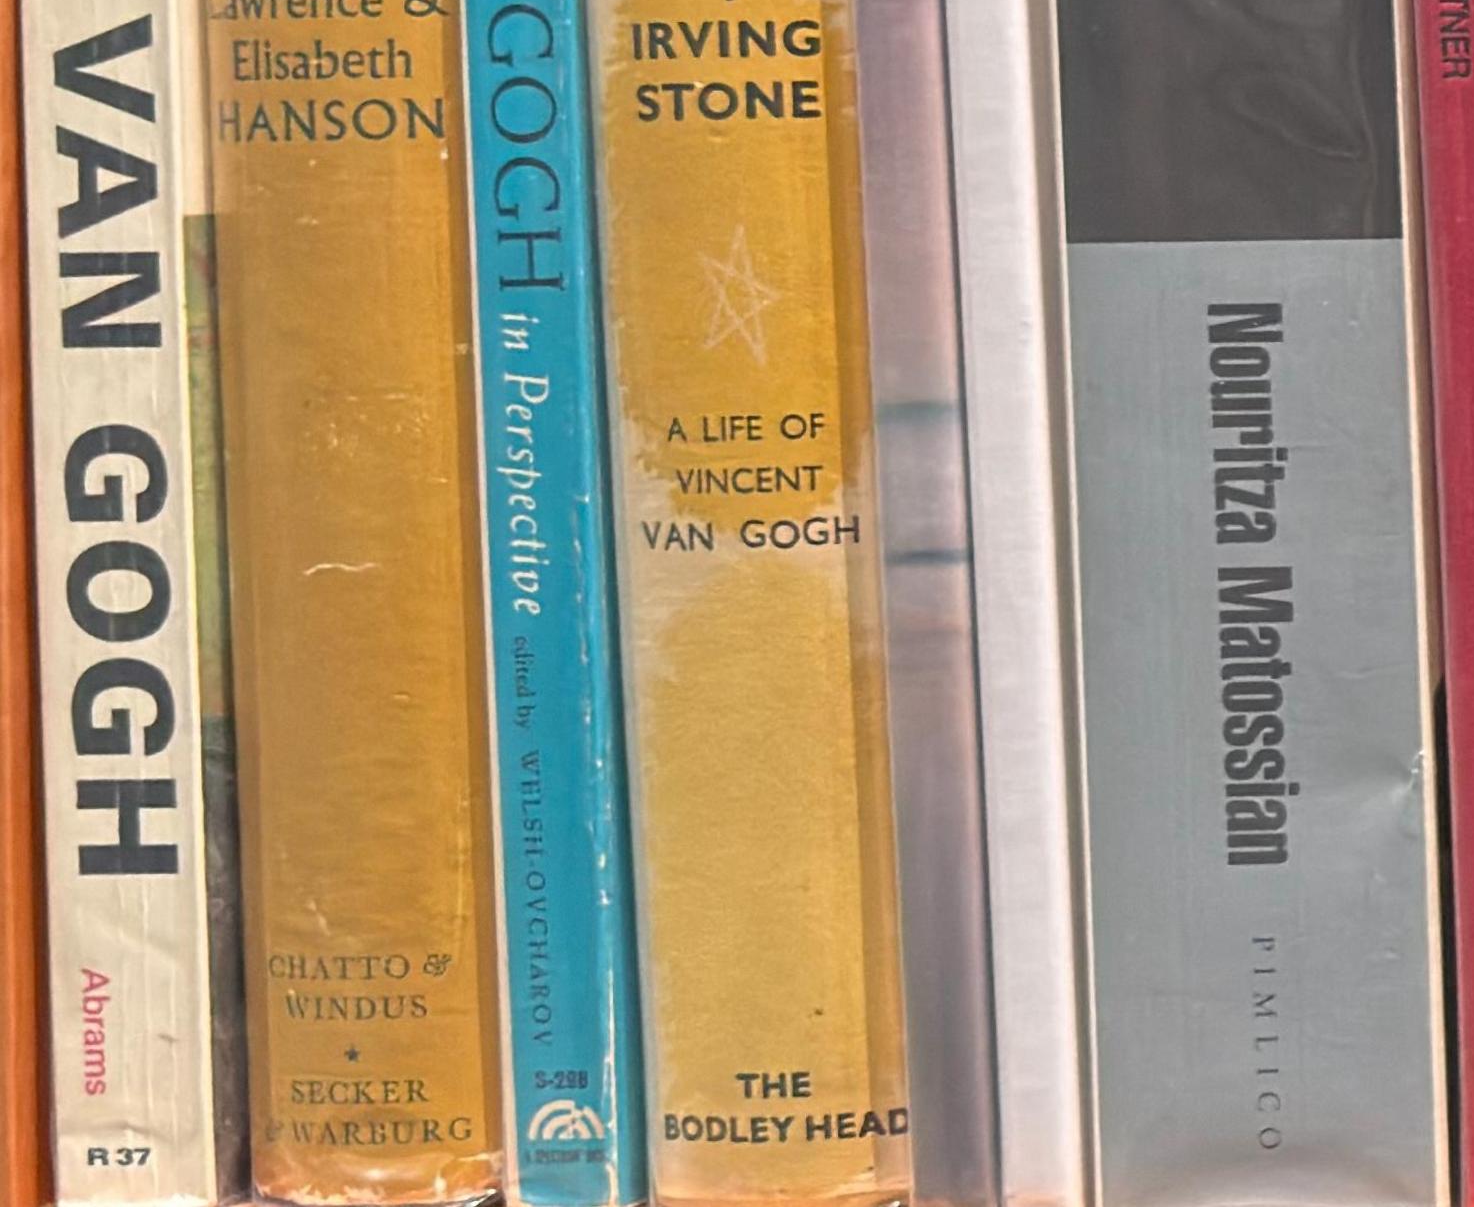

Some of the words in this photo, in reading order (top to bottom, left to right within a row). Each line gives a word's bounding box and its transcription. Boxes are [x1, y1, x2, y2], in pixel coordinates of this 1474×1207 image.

[232, 37, 413, 81] Elisabeth
[631, 19, 822, 62] IRVING
[218, 97, 446, 143] HANSON
[636, 79, 822, 121] STONE
[487, 4, 567, 292] GOGH
[53, 13, 162, 349] VAN
[499, 313, 539, 352] in
[667, 417, 689, 444] A
[701, 413, 764, 445] LIFE
[779, 411, 827, 443] OF
[1207, 303, 1289, 546] Nouritza
[497, 372, 550, 616] Perspective
[675, 465, 823, 496] VINCENT
[642, 519, 715, 552] VAN
[739, 515, 861, 551] GOGH
[64, 423, 179, 876] GOGH
[513, 636, 537, 697] edited
[513, 703, 538, 731] by
[1217, 566, 1300, 868] Matossian
[268, 954, 411, 981] CHATTO
[285, 994, 428, 1022] WINDUS
[81, 967, 110, 1097] Abrams
[1251, 936, 1283, 1152] PIMLICO
[290, 1079, 430, 1105] SECKER
[735, 1071, 813, 1099] THE
[292, 1116, 473, 1146] WARBURG
[664, 1112, 796, 1144] BODLEY
[805, 1107, 909, 1142] HEAD
[87, 1146, 109, 1167] R
[115, 1146, 152, 1167] 37
